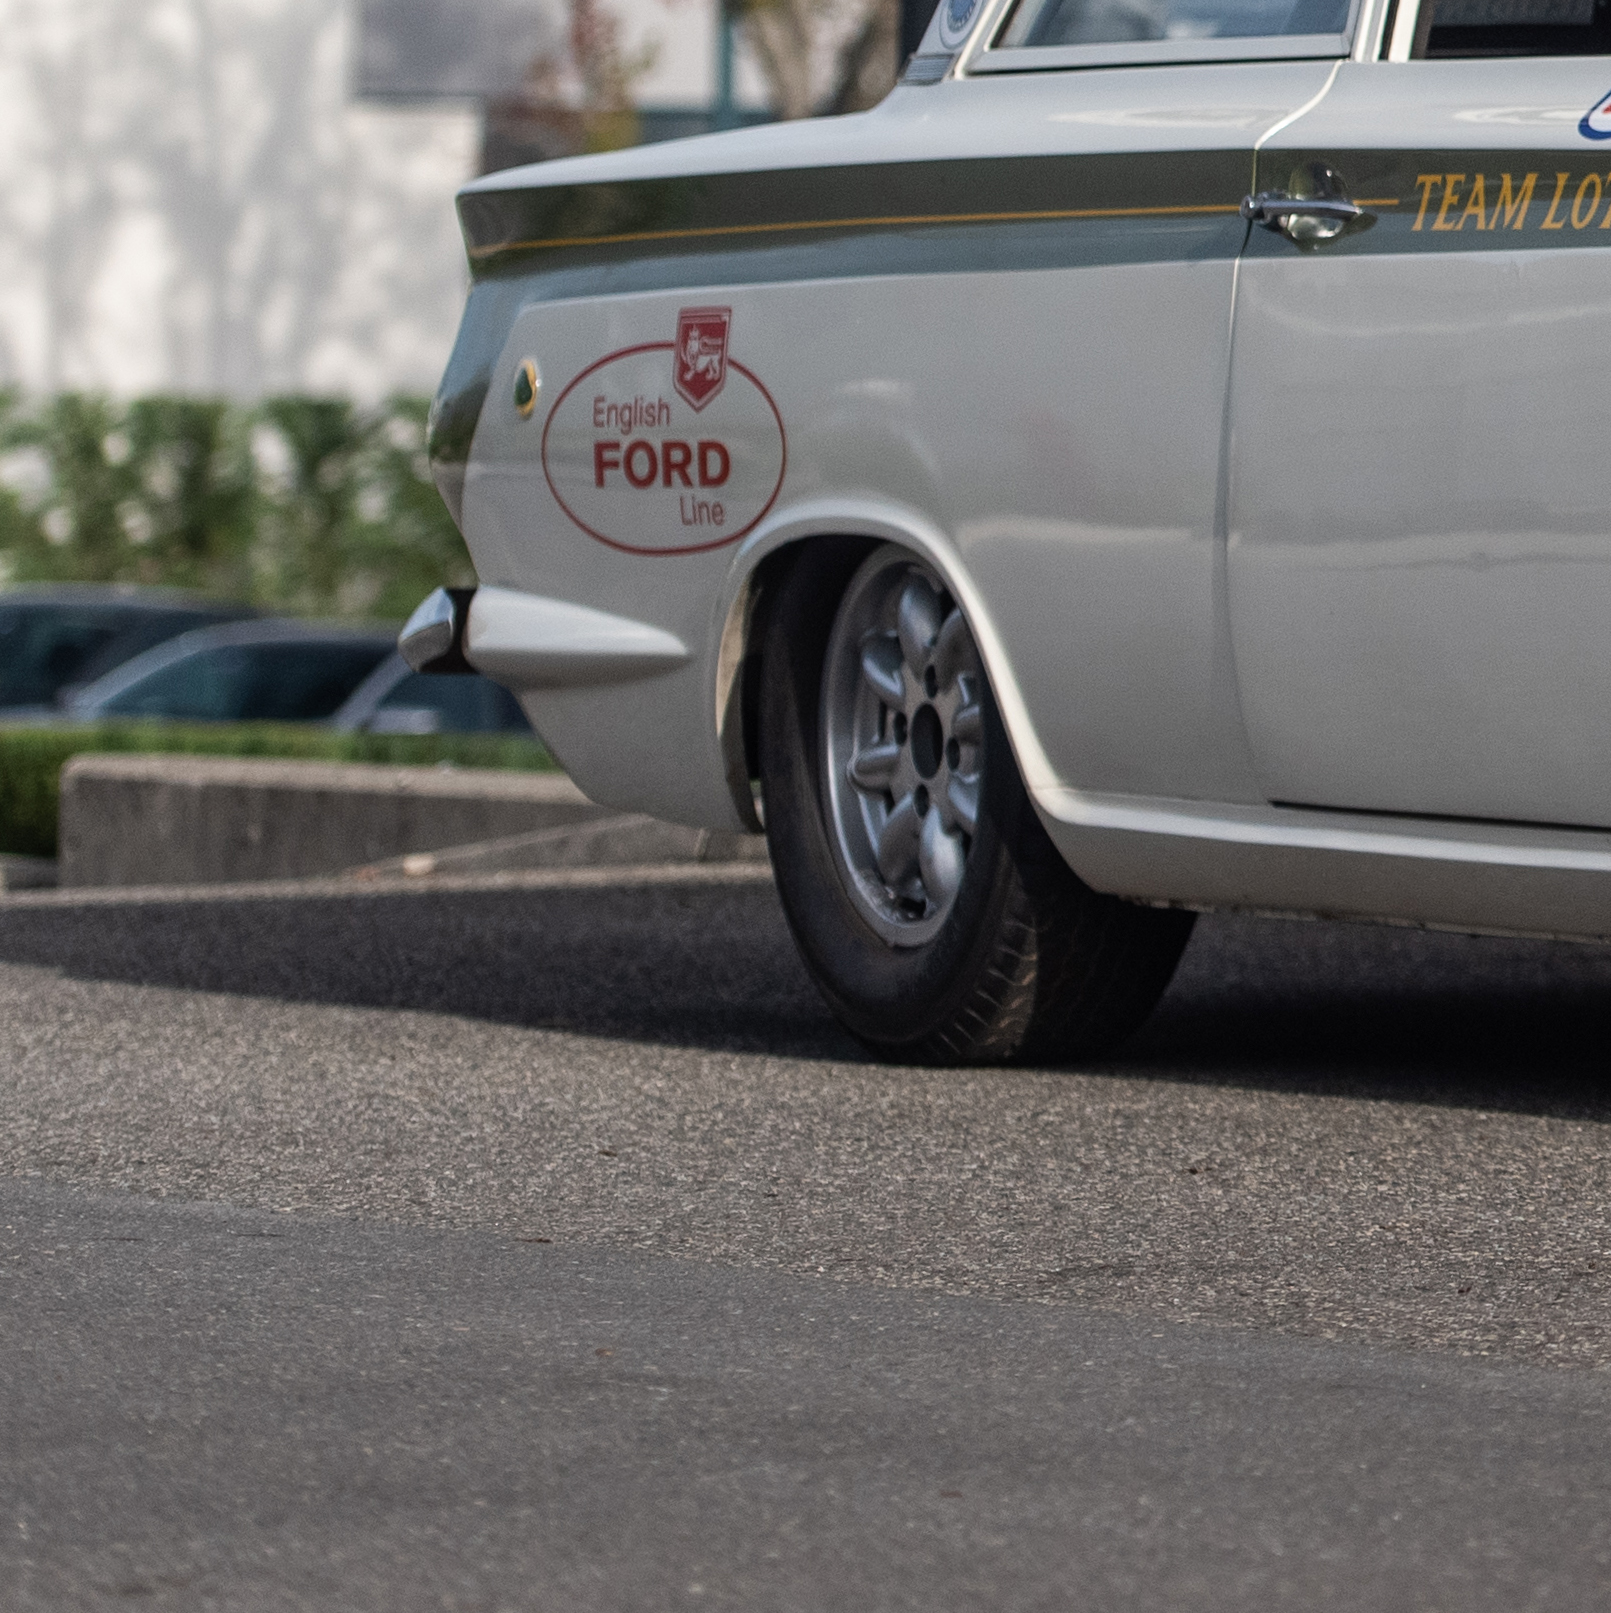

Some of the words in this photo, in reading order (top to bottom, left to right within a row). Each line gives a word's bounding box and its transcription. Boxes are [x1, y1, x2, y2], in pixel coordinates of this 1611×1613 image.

[1411, 171, 1539, 231] TEAM
[592, 395, 671, 436] English
[593, 439, 731, 489] FORD
[679, 495, 726, 527] Line
